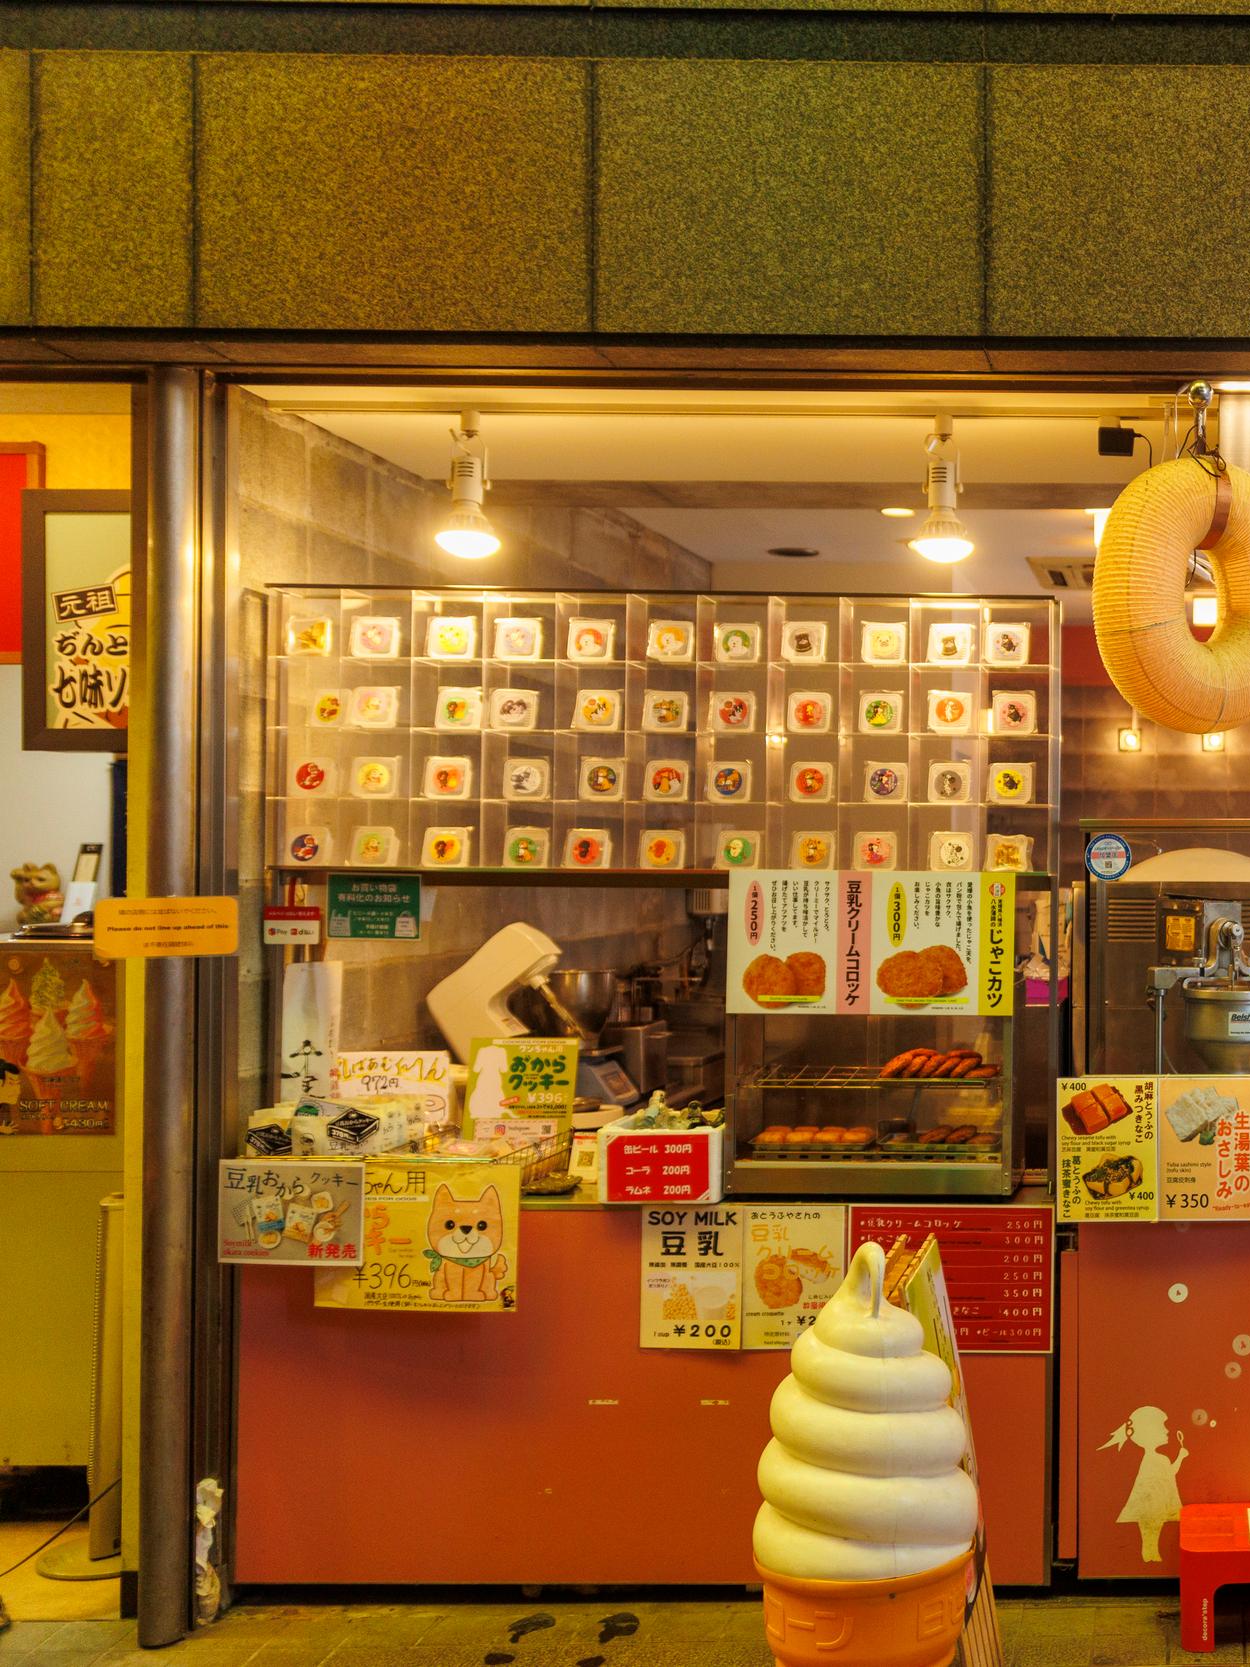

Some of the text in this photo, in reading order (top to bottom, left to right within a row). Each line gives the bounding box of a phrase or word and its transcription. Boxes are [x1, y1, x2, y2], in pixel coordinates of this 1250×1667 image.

[60, 591, 114, 617] 元祖
[844, 880, 863, 1006] 豆乳クリームコロッケ
[986, 928, 1005, 1008] じゃこカツ
[510, 1054, 567, 1074] おから
[361, 1075, 400, 1093] 972円
[508, 1073, 570, 1092] クッキー
[1061, 1082, 1087, 1092] ¥400
[60, 1100, 108, 1112] CREAM
[527, 1092, 563, 1104] ¥396
[1134, 1084, 1144, 1144] 黒みつきなこ
[1144, 1081, 1154, 1141] 胡麻とうふの
[623, 1143, 693, 1155] 缶ビール 300円
[1233, 1110, 1250, 1193] 生湯葉の
[1216, 1118, 1233, 1200] おさしみ
[625, 1165, 691, 1176] コーラ 200円
[224, 1167, 359, 1199] 豆乳おから クッキー
[1072, 1155, 1081, 1205] 葛とうふの
[625, 1184, 691, 1195] ラムネ 200円
[1062, 1159, 1071, 1218] 抹茶蜜きなこ
[1128, 1191, 1154, 1202] ¥400
[1165, 1193, 1210, 1209] ¥350
[648, 1210, 738, 1226] SOY MILK
[750, 1211, 822, 1221] おとうふやさんの
[751, 1223, 791, 1243] 豆乳
[1007, 1220, 1043, 1230] 250円
[660, 1230, 724, 1257] 豆乳
[1004, 1236, 1043, 1245] 300円
[307, 1243, 358, 1259] 新発売
[756, 1245, 835, 1261] クリーム
[1003, 1254, 1043, 1264] 200円
[1003, 1271, 1043, 1281] 250円
[1003, 1288, 1043, 1298] 350円
[1003, 1307, 1043, 1317] 400円
[673, 1324, 732, 1338] ¥200
